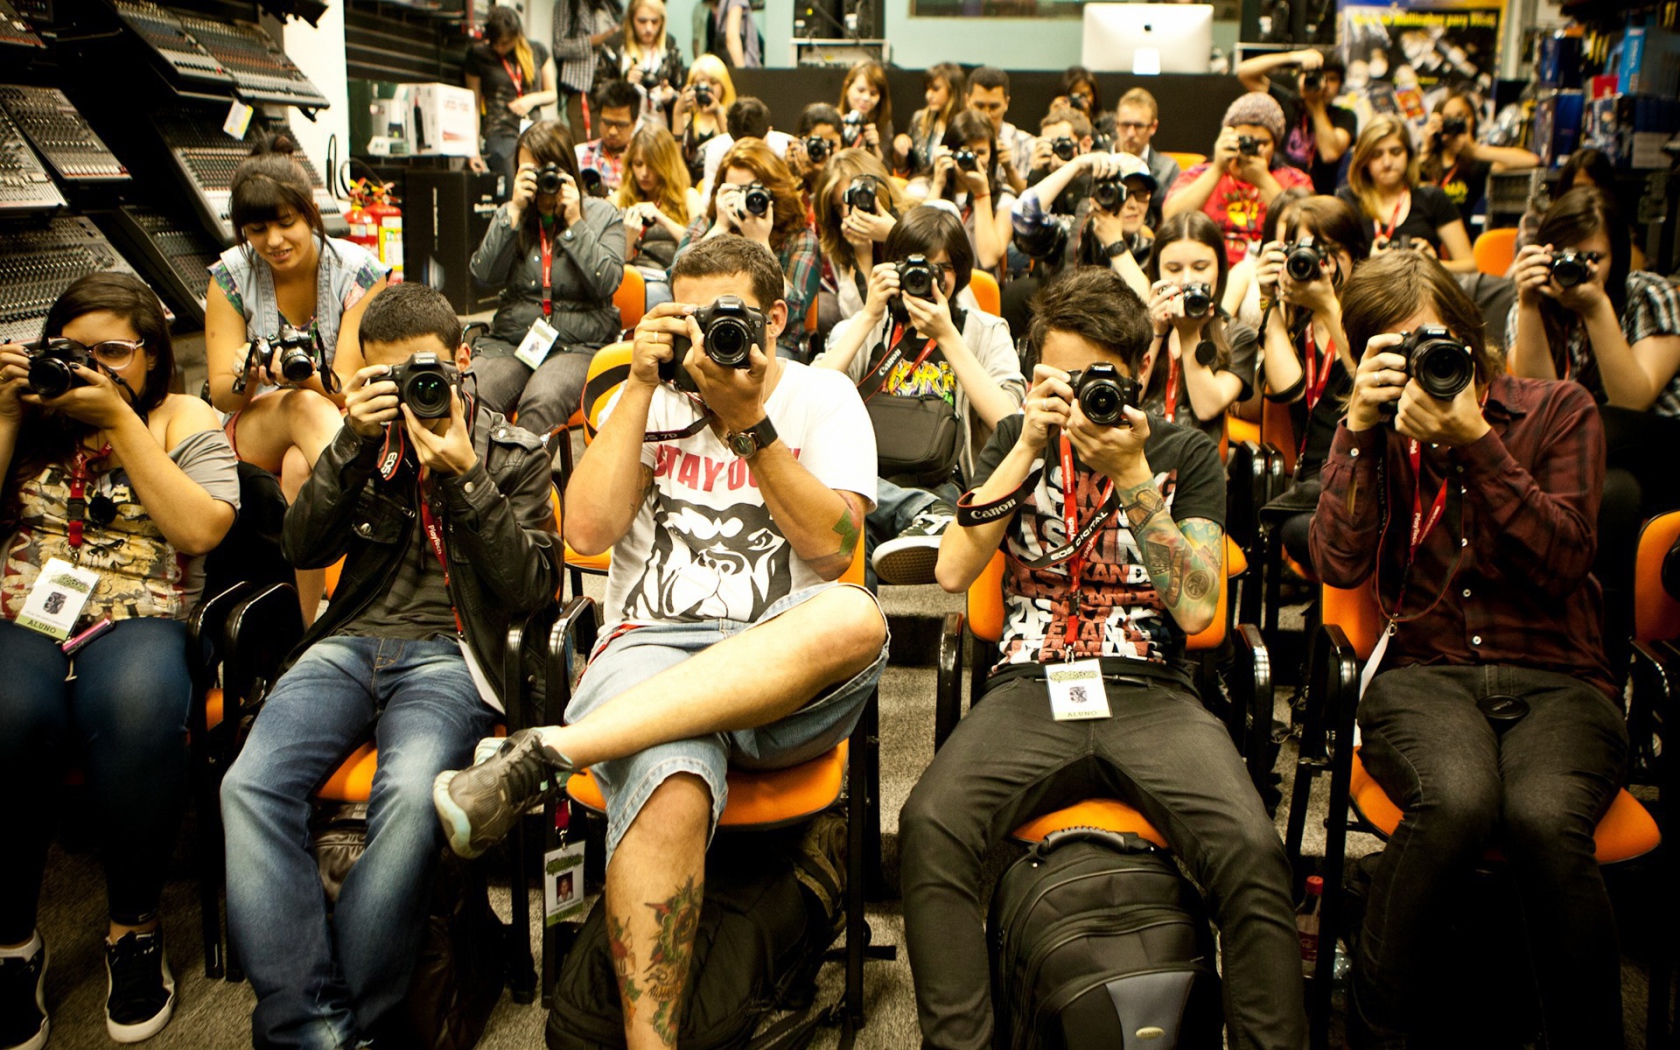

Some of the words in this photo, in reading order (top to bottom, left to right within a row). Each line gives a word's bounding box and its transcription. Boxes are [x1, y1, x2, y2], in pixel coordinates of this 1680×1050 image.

[878, 348, 902, 376] Canon
[380, 452, 398, 475] EOS
[654, 443, 725, 492] STAY
[970, 498, 1017, 520] Canon
[427, 524, 442, 554] PlayTech
[1050, 545, 1075, 561] EOS
[1075, 511, 1108, 547] DIGITAL
[27, 619, 57, 635] ALUNO
[1067, 710, 1098, 718] ALUNO
